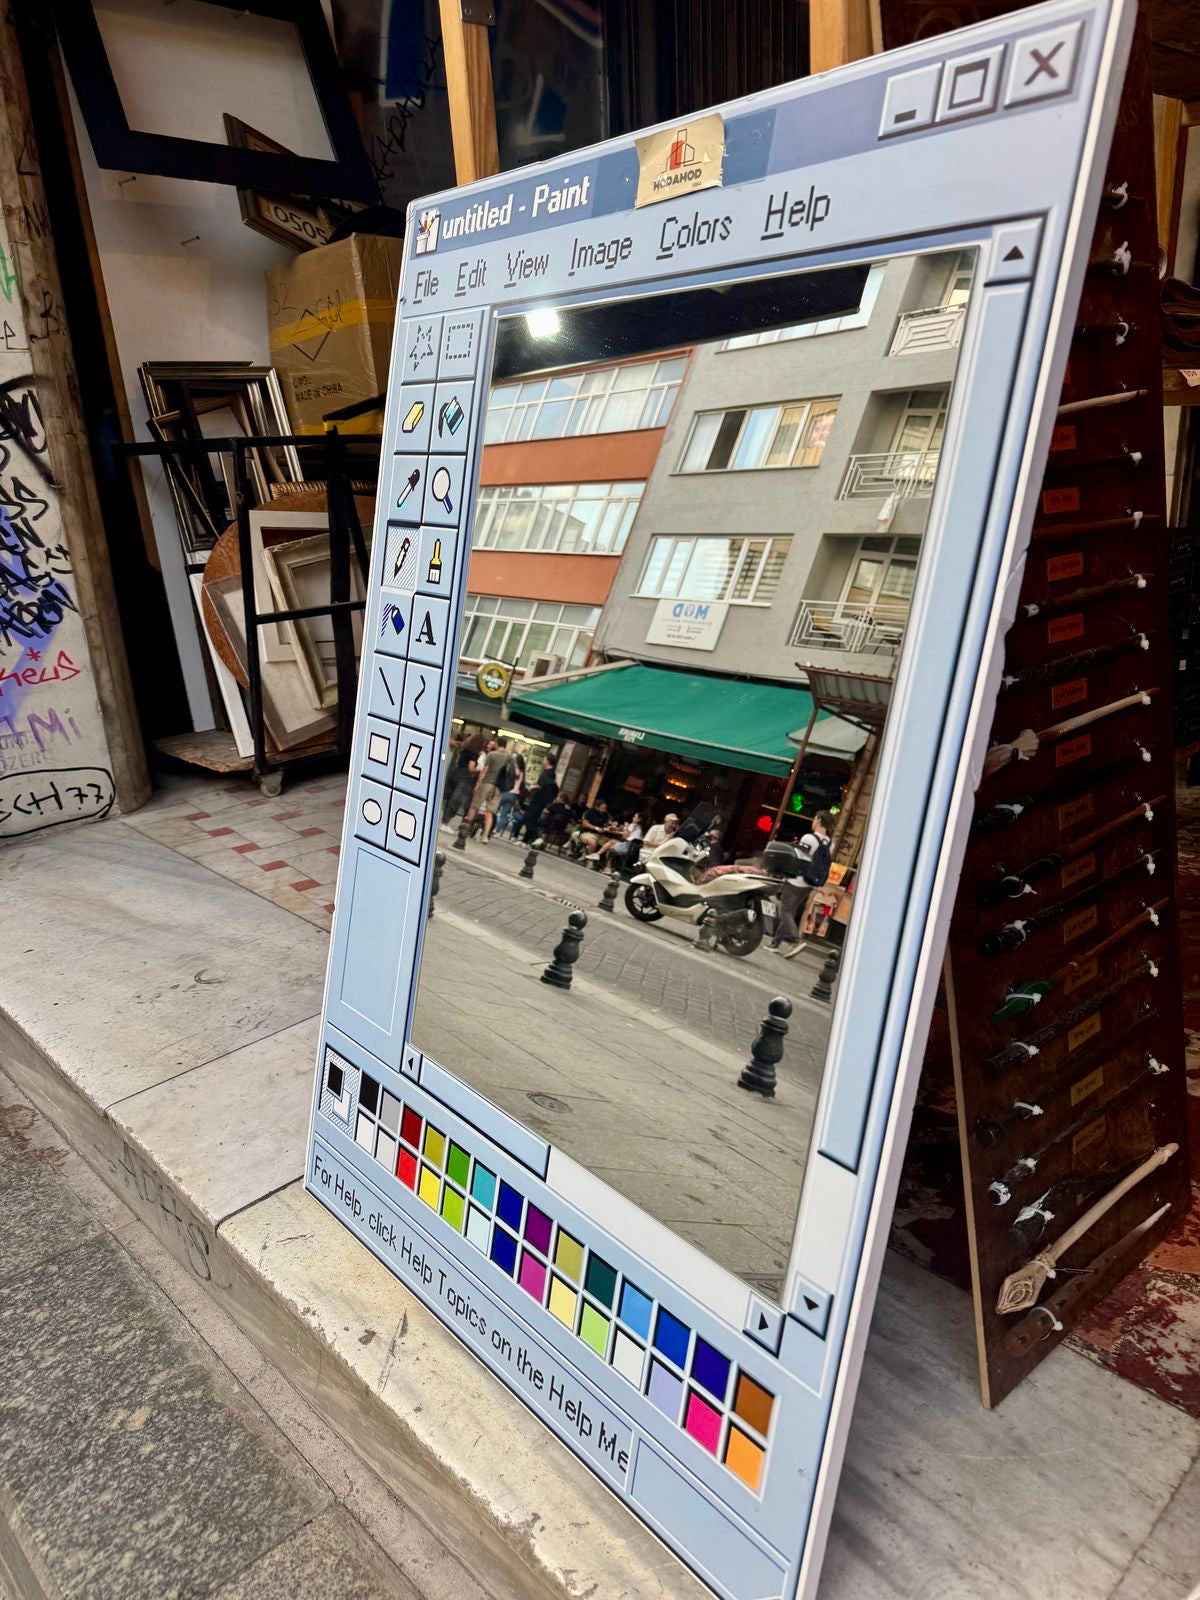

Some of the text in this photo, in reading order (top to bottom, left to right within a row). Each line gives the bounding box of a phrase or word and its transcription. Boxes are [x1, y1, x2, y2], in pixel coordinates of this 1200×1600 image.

[414, 184, 832, 300] File Edit View Image Colors Help
[442, 193, 514, 240] untitled
[531, 175, 591, 218] Paint
[313, 1154, 332, 1189] For
[334, 1173, 365, 1223] Help,
[368, 1211, 397, 1252] click
[401, 1235, 433, 1286] Help
[438, 1268, 487, 1336] Topics
[491, 1329, 512, 1362] on
[516, 1346, 545, 1391] the
[549, 1375, 593, 1438] Help
